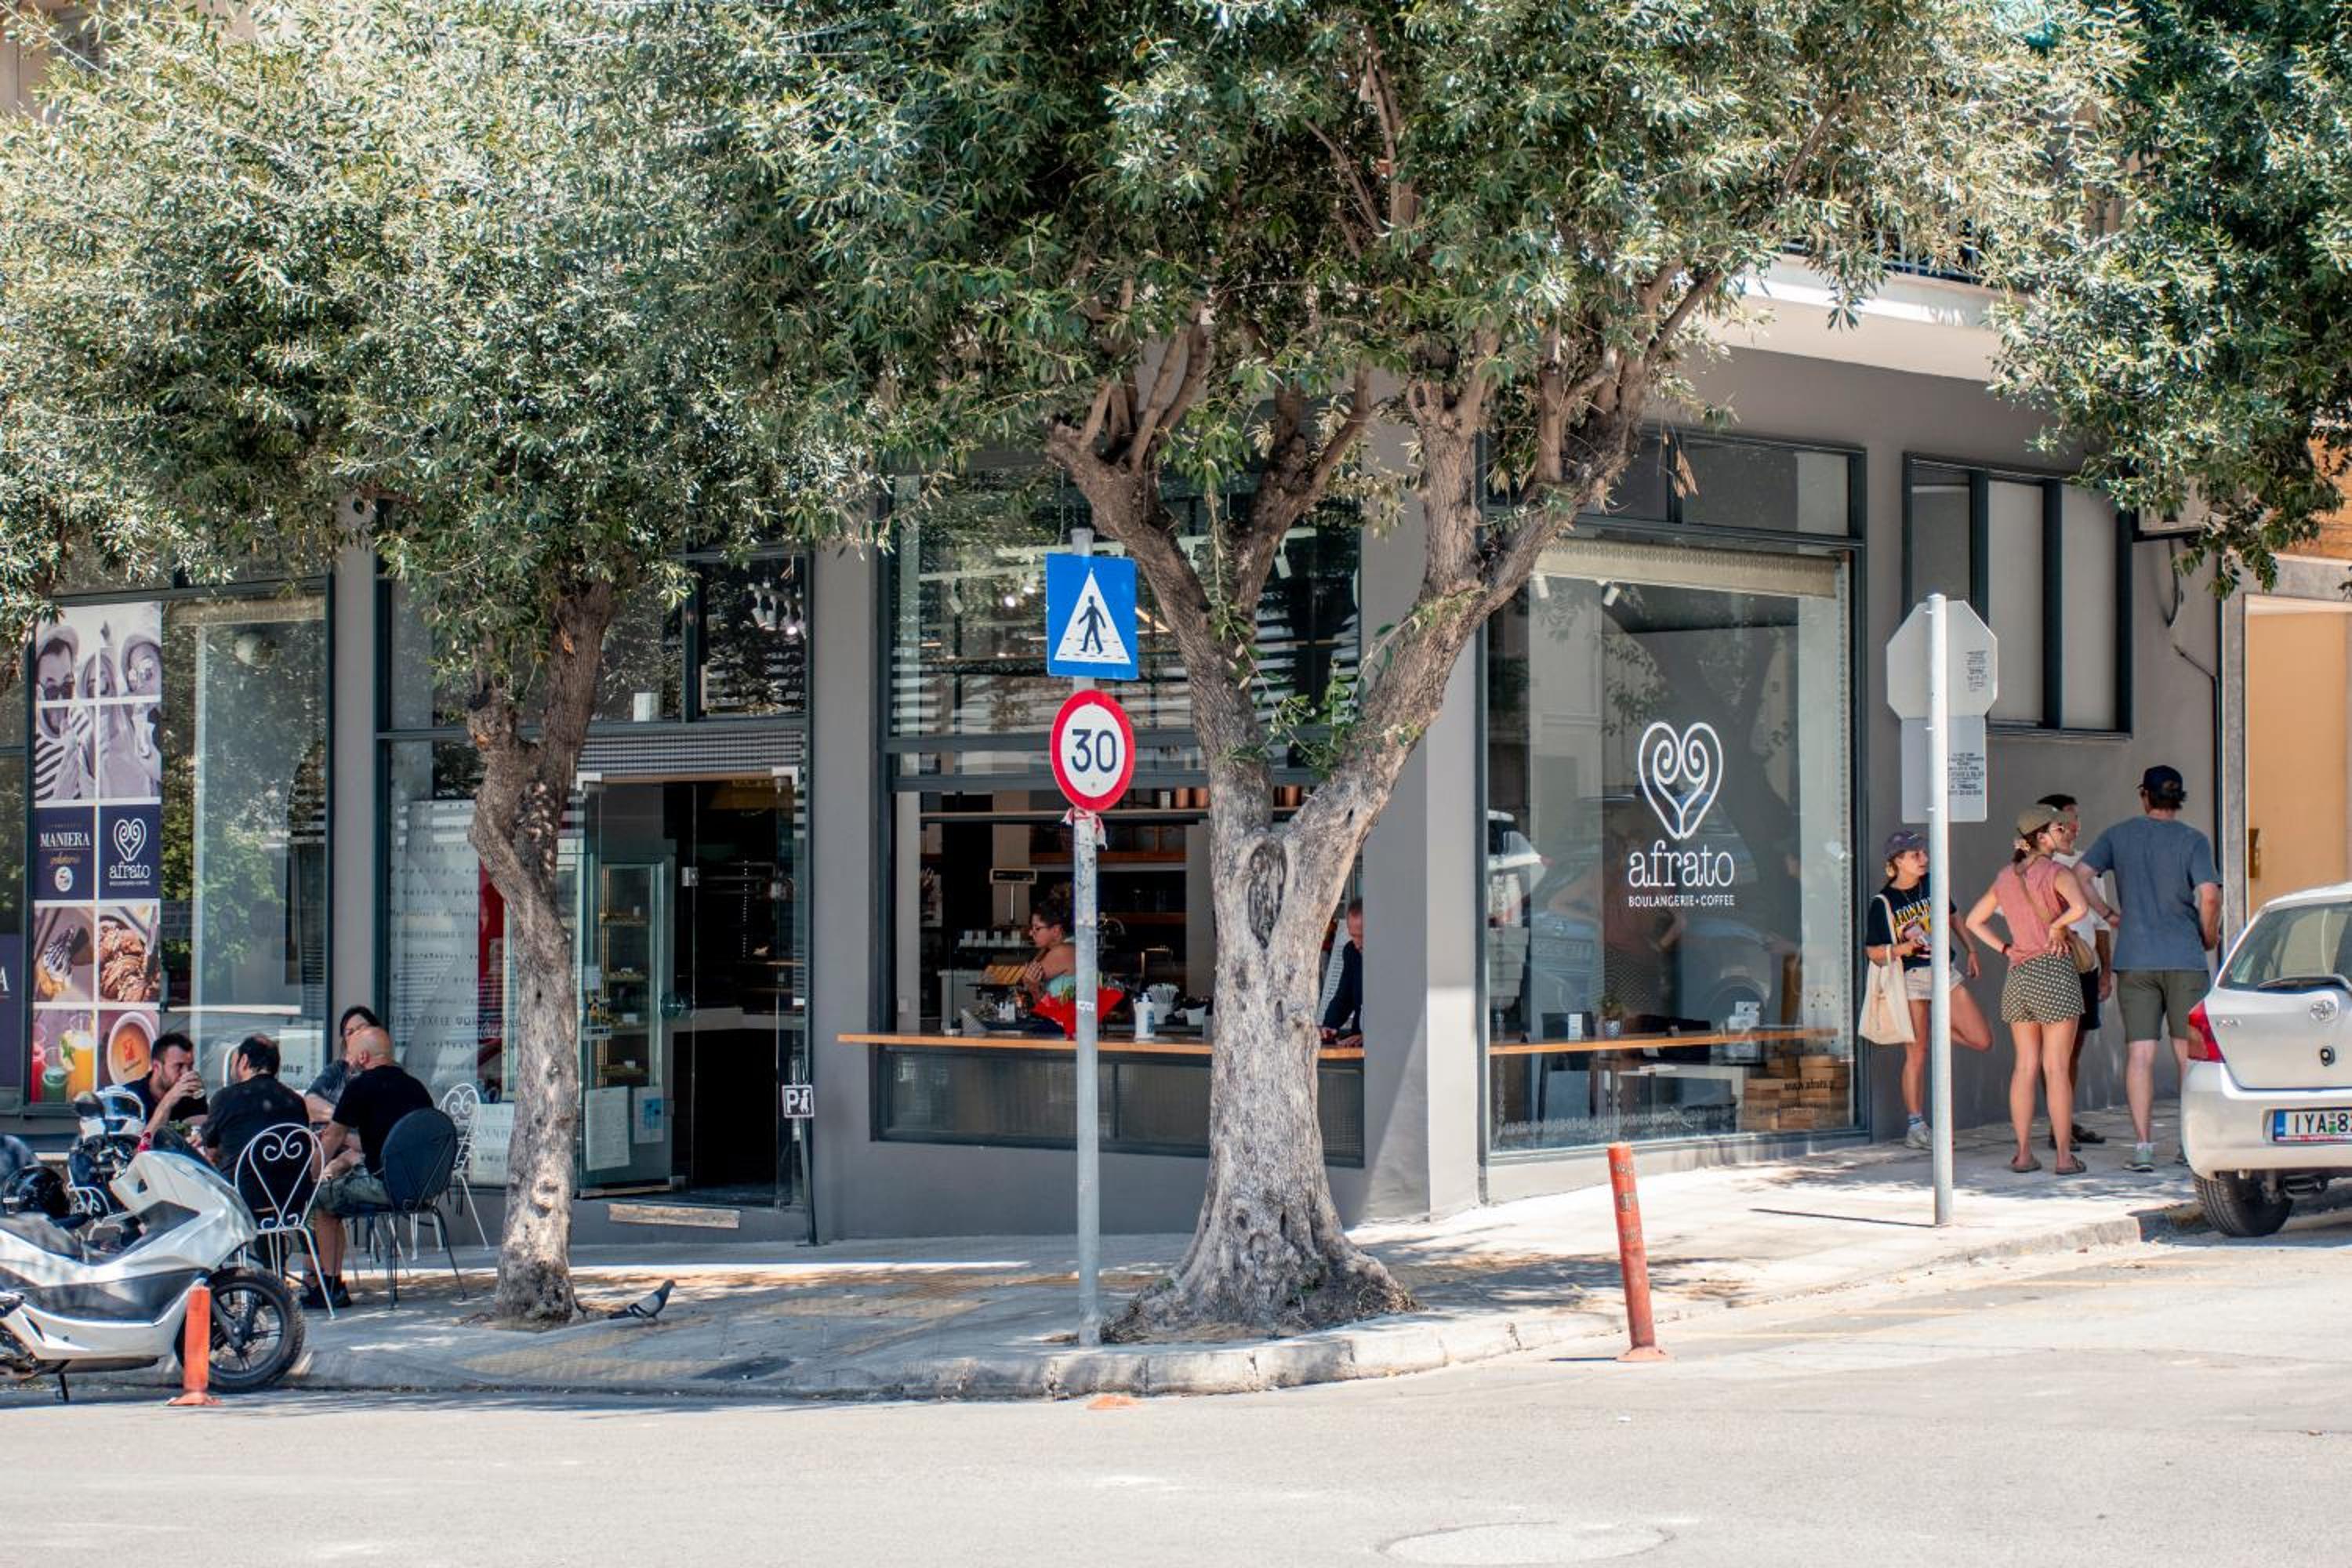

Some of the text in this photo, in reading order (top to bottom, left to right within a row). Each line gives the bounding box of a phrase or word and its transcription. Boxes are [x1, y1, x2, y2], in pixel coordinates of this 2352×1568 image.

[1071, 728, 1116, 773] 30
[39, 832, 90, 848] MANIERA
[109, 861, 151, 879] afrato
[1628, 840, 1735, 887] afrato
